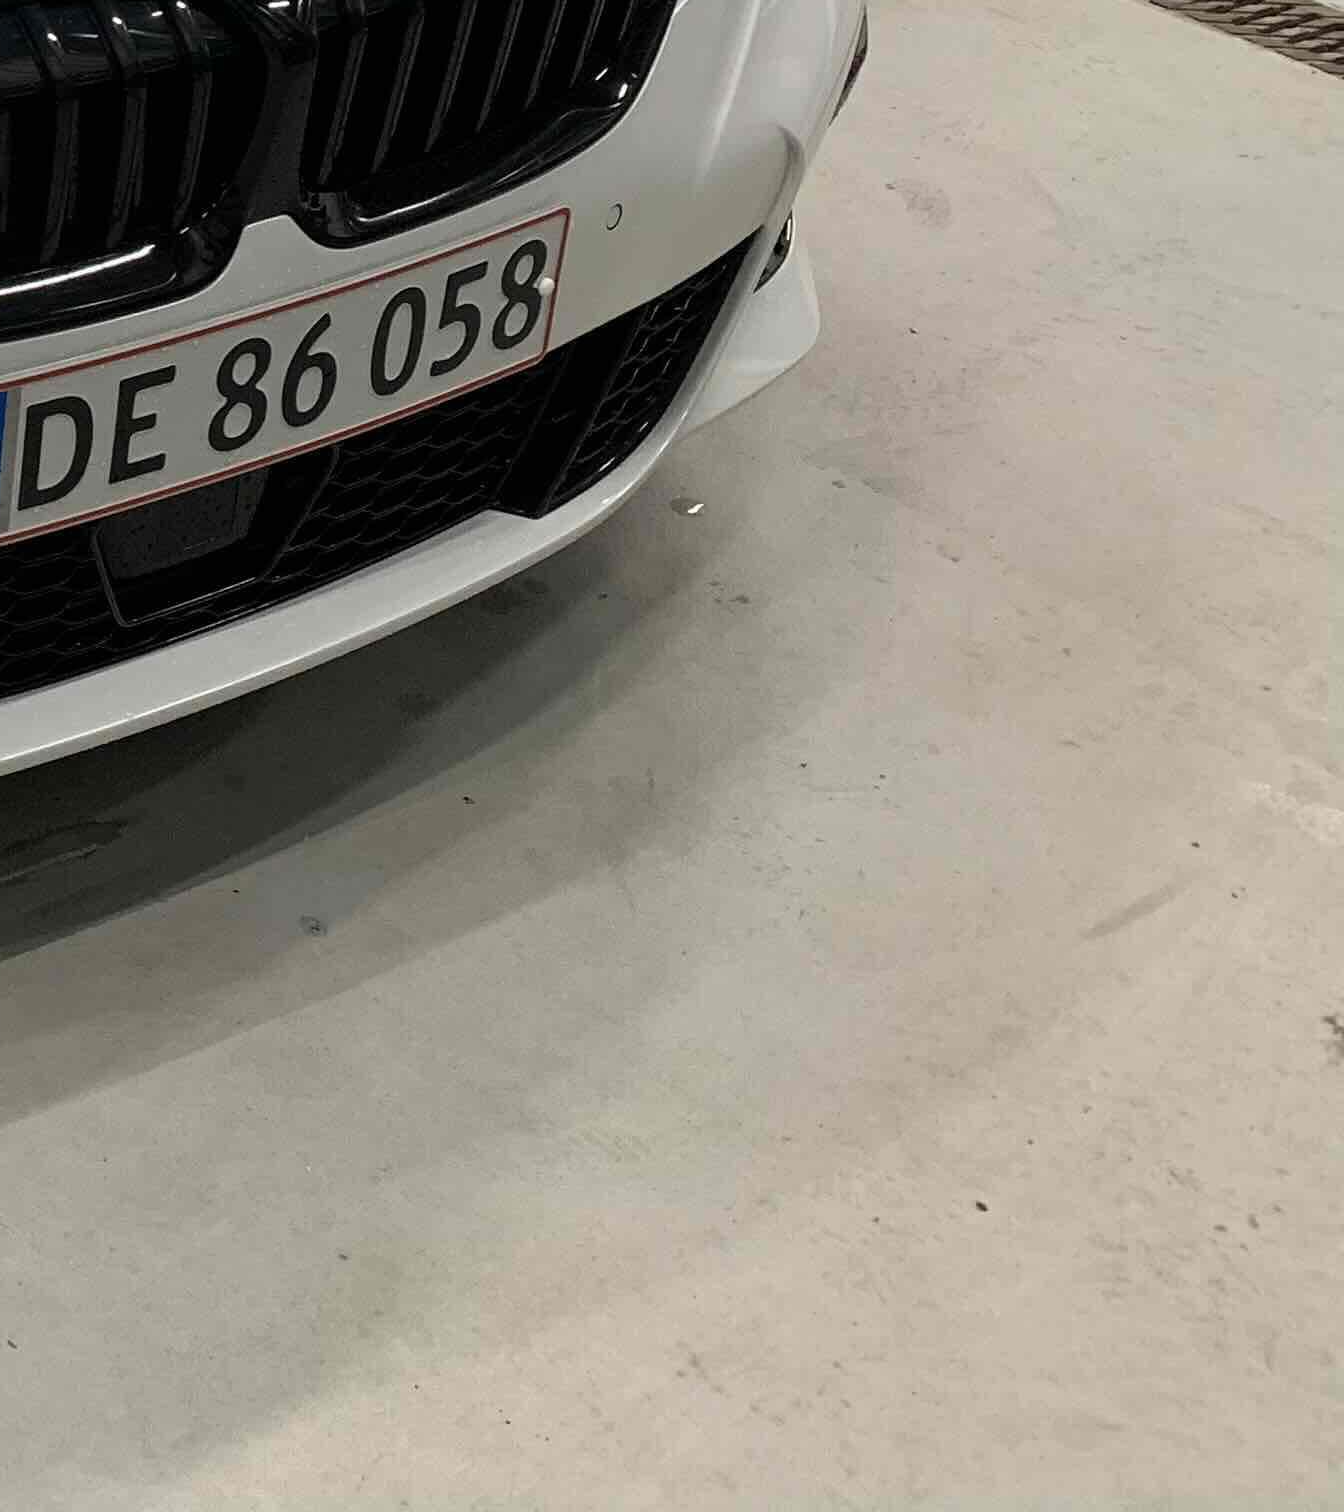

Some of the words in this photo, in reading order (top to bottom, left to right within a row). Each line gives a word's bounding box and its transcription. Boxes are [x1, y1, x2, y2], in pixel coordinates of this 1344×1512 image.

[17, 365, 176, 511] DE
[208, 312, 337, 452] 86
[370, 239, 548, 396] 058
